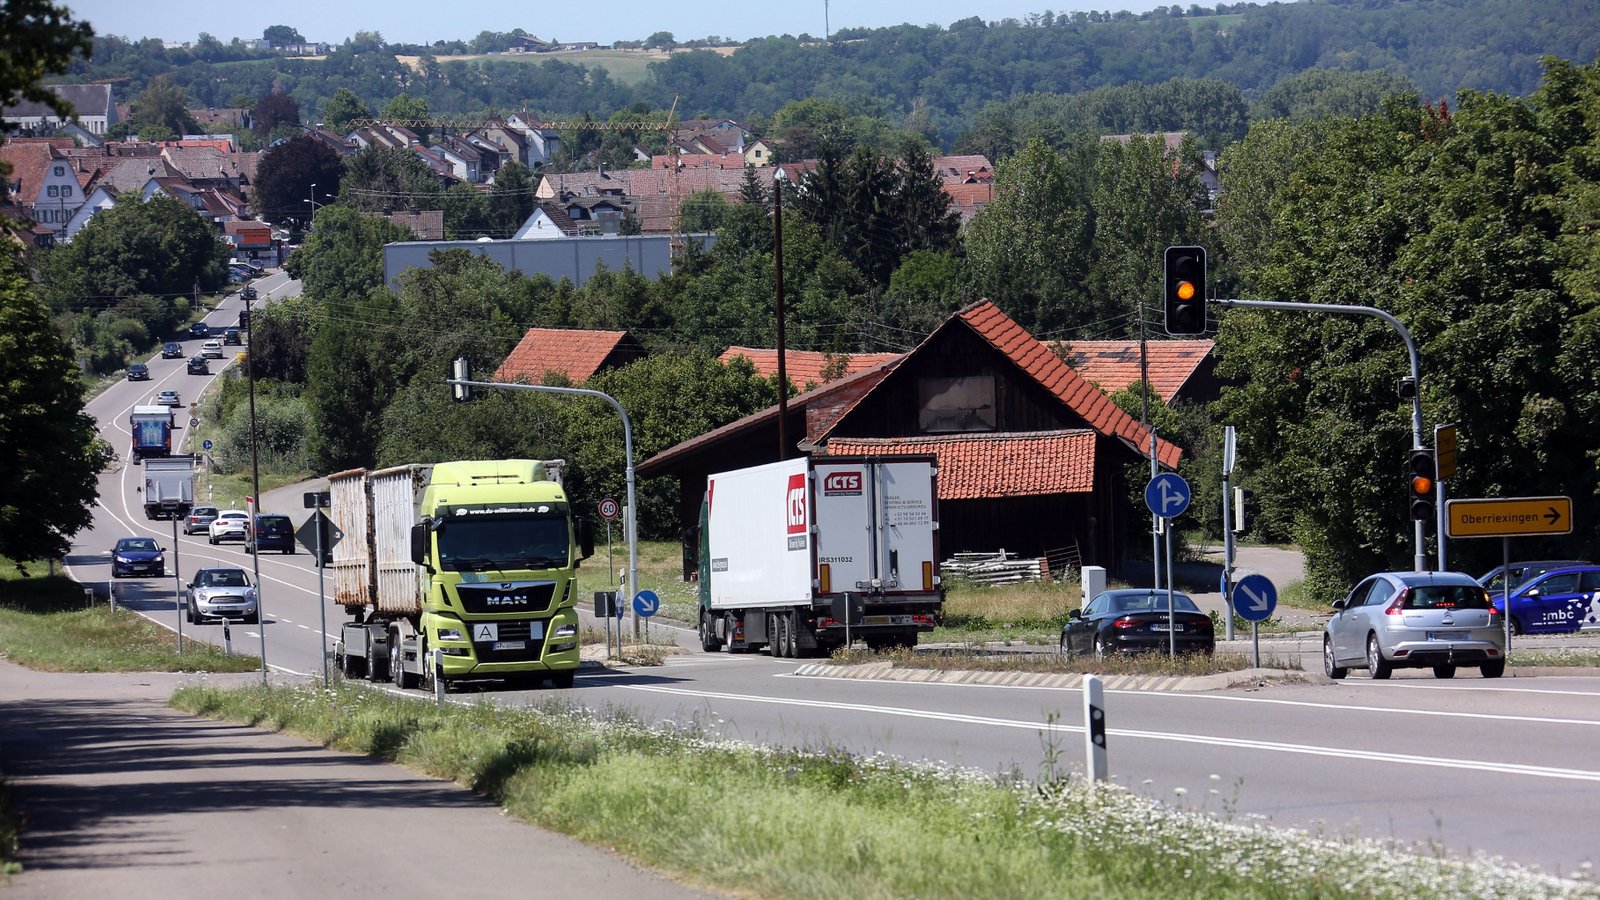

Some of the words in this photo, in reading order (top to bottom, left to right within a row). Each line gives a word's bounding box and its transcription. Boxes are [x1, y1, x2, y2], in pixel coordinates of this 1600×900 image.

[828, 475, 859, 489] ICTS
[603, 504, 614, 514] 60
[788, 487, 805, 527] ICTS
[1461, 513, 1539, 524] Oberriexingen
[486, 595, 528, 606] MAN
[479, 625, 493, 639] A
